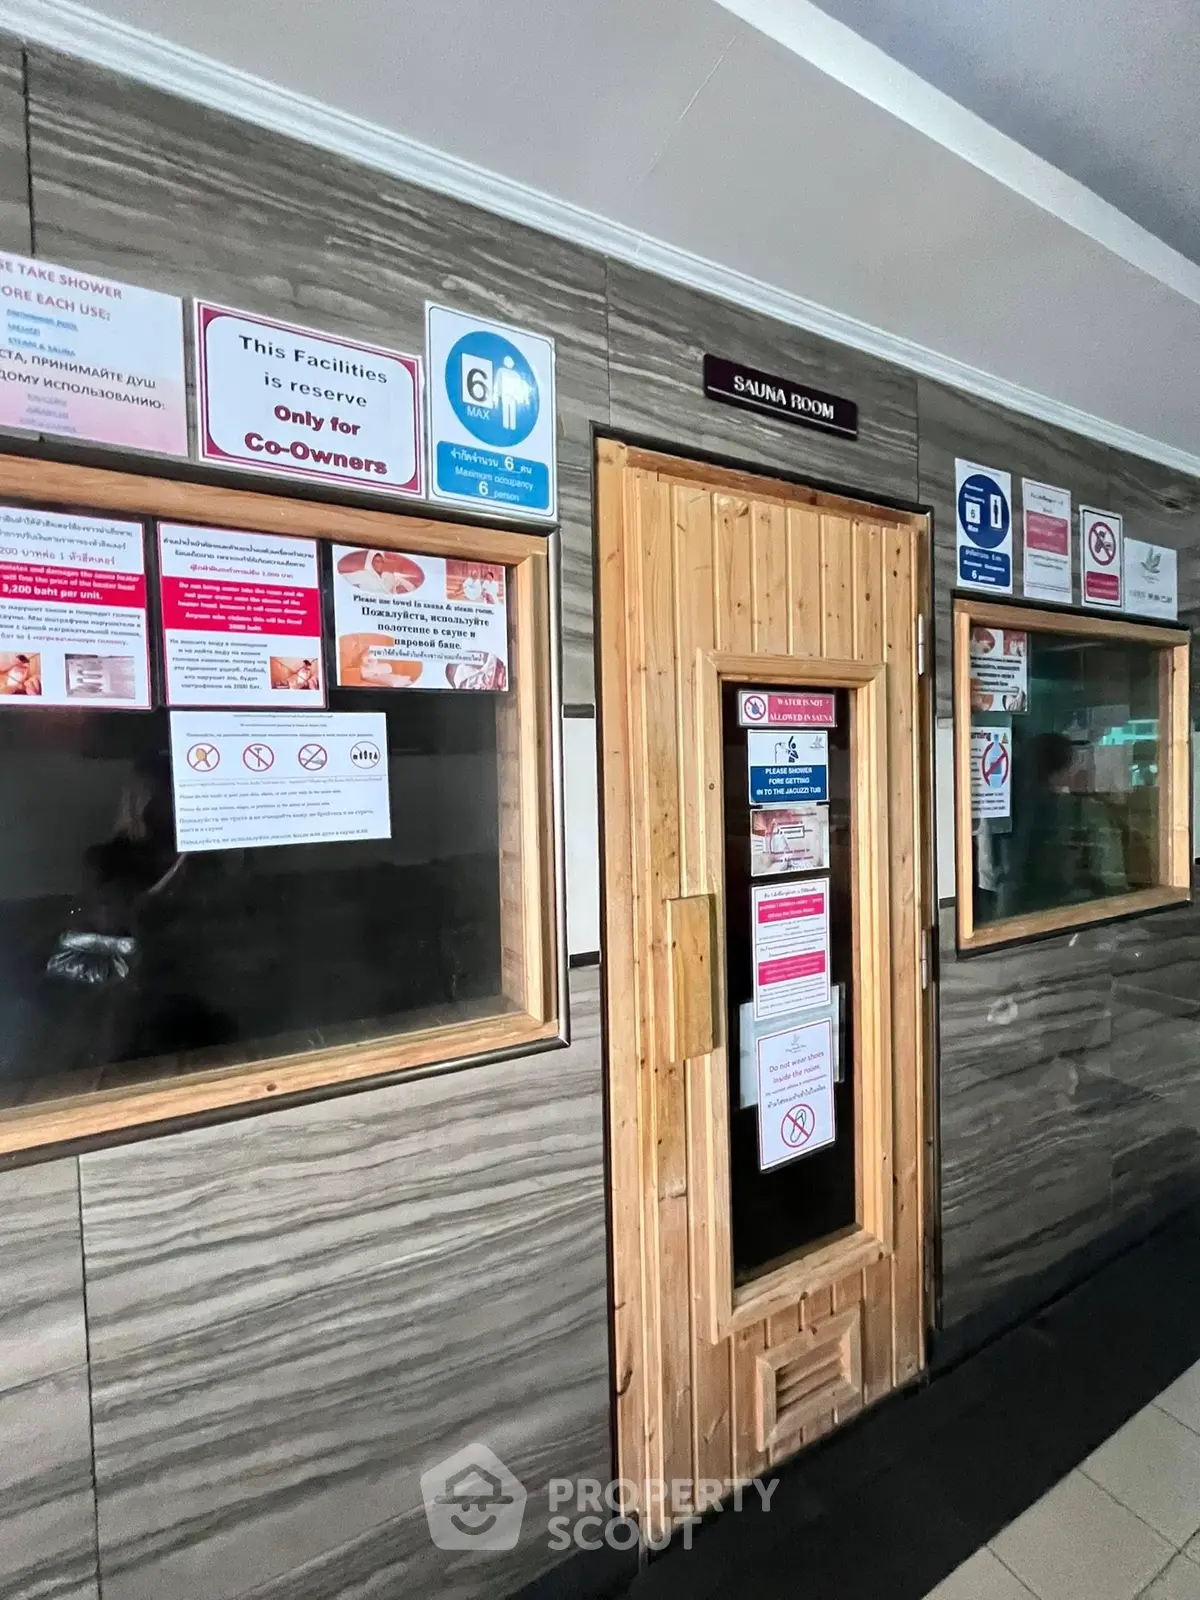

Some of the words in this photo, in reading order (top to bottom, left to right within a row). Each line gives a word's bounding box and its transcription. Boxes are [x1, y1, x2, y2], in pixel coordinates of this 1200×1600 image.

[18, 263, 55, 283] TAKE
[59, 274, 123, 300] SHOWER
[37, 293, 75, 312] EACH
[238, 335, 286, 359] This
[294, 349, 388, 384] Facilities
[31, 355, 123, 382] ПРИНИМАЙТЕ
[126, 375, 156, 389] ДУШ
[43, 379, 165, 410] ИСПОЛЬЗОВАНИЮ:
[264, 372, 282, 388] is
[290, 381, 368, 408] reserve
[466, 367, 488, 402] 6
[733, 375, 787, 405] SAUNA
[790, 393, 835, 420] ROOM
[273, 404, 325, 432] Only
[330, 416, 361, 436] for
[466, 407, 491, 421] MAX
[244, 432, 388, 475] Co-Owners
[504, 455, 515, 471] 6
[455, 465, 493, 482] Maximum
[494, 475, 534, 492] occupancy
[478, 481, 489, 497] 6
[493, 489, 520, 502] person
[970, 509, 976, 519] 6
[971, 570, 977, 579] 6
[34, 585, 58, 596] baht
[60, 589, 77, 598] per
[80, 589, 103, 600] unit.
[353, 595, 377, 604] Please
[392, 598, 412, 607] towel
[361, 606, 429, 623] Пожалуйста,
[430, 615, 490, 628] используйте
[394, 637, 436, 649] паровой
[777, 697, 802, 707] WATER
[769, 712, 803, 721] ALLOWED
[811, 713, 832, 723] SAUNA
[765, 767, 788, 775] PLEASE
[785, 777, 810, 785] GETTING
[769, 1065, 779, 1073] Do
[779, 1061, 790, 1069] not
[791, 1056, 807, 1066] wear
[807, 1051, 825, 1060] shoes
[792, 1069, 803, 1078] the
